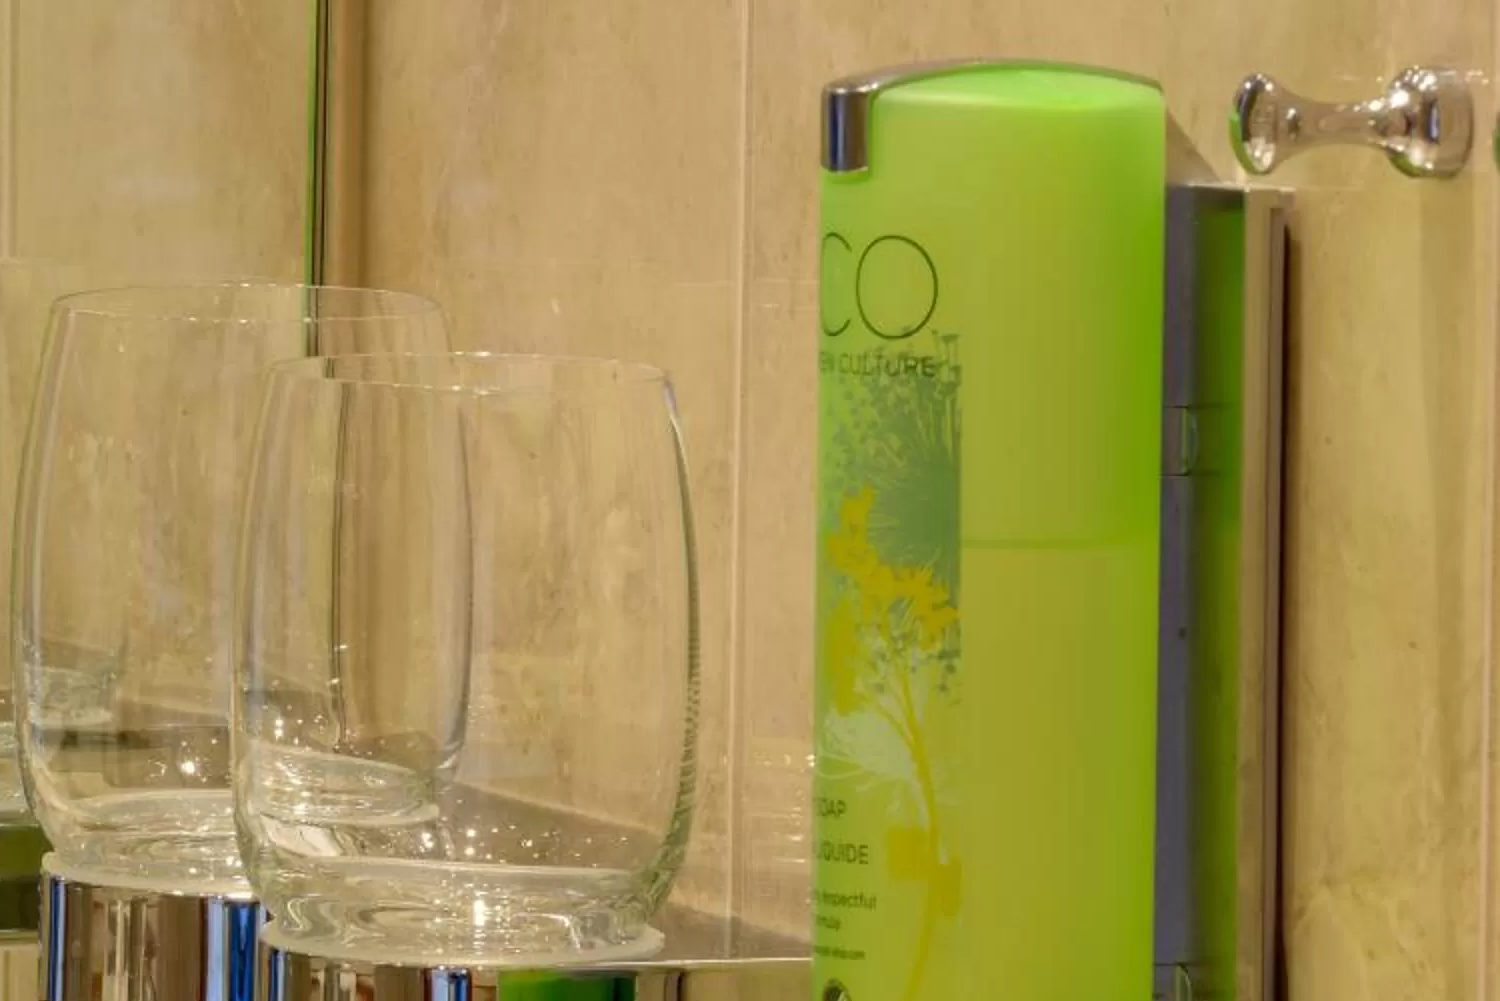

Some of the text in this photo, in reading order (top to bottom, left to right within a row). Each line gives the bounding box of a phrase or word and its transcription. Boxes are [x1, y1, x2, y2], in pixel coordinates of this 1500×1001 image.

[838, 352, 938, 378] CULTURE
[816, 798, 847, 819] OAP
[816, 840, 869, 865] QUIDE
